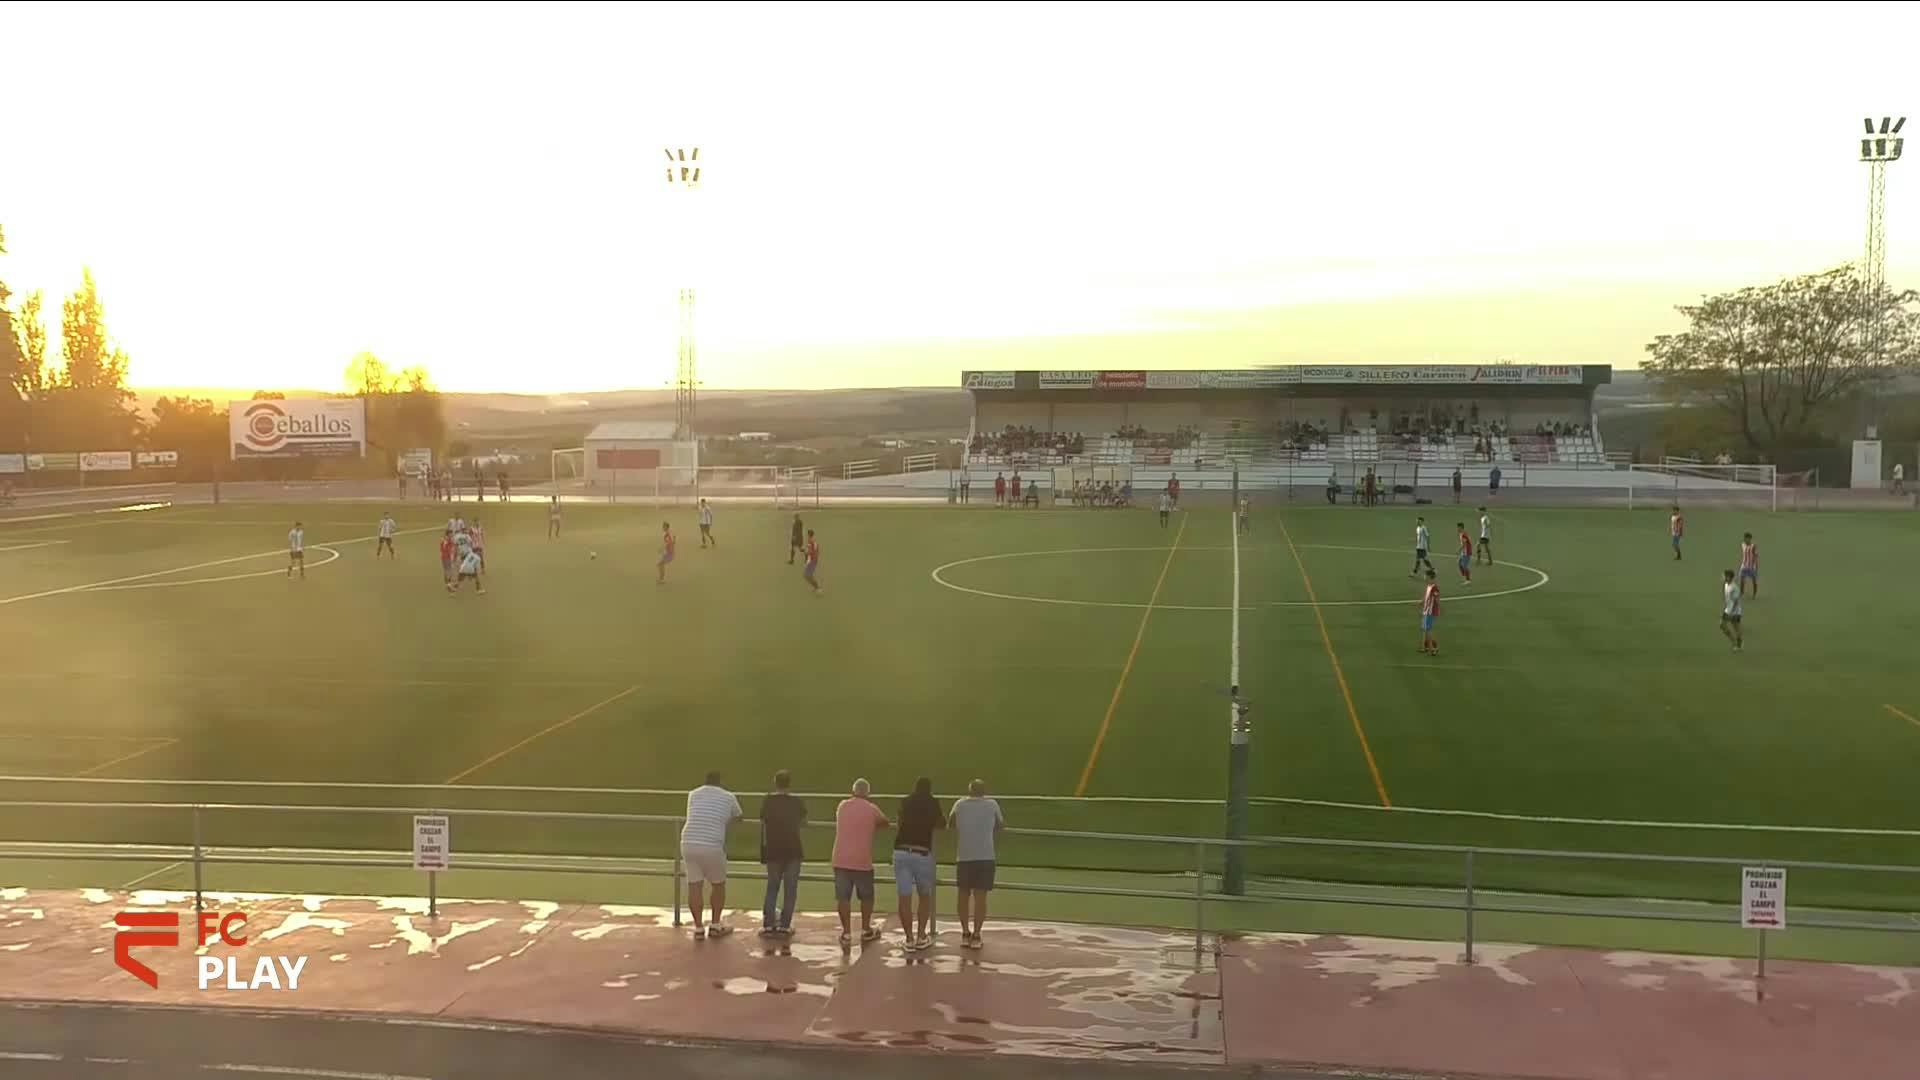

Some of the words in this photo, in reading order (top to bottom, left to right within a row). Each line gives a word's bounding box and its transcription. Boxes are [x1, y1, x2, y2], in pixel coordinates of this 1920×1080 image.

[1745, 870, 1782, 879] PROHIBIDO
[1750, 880, 1777, 888] CRUZAR
[1759, 890, 1767, 898] EL
[1751, 900, 1775, 908] CAMPO
